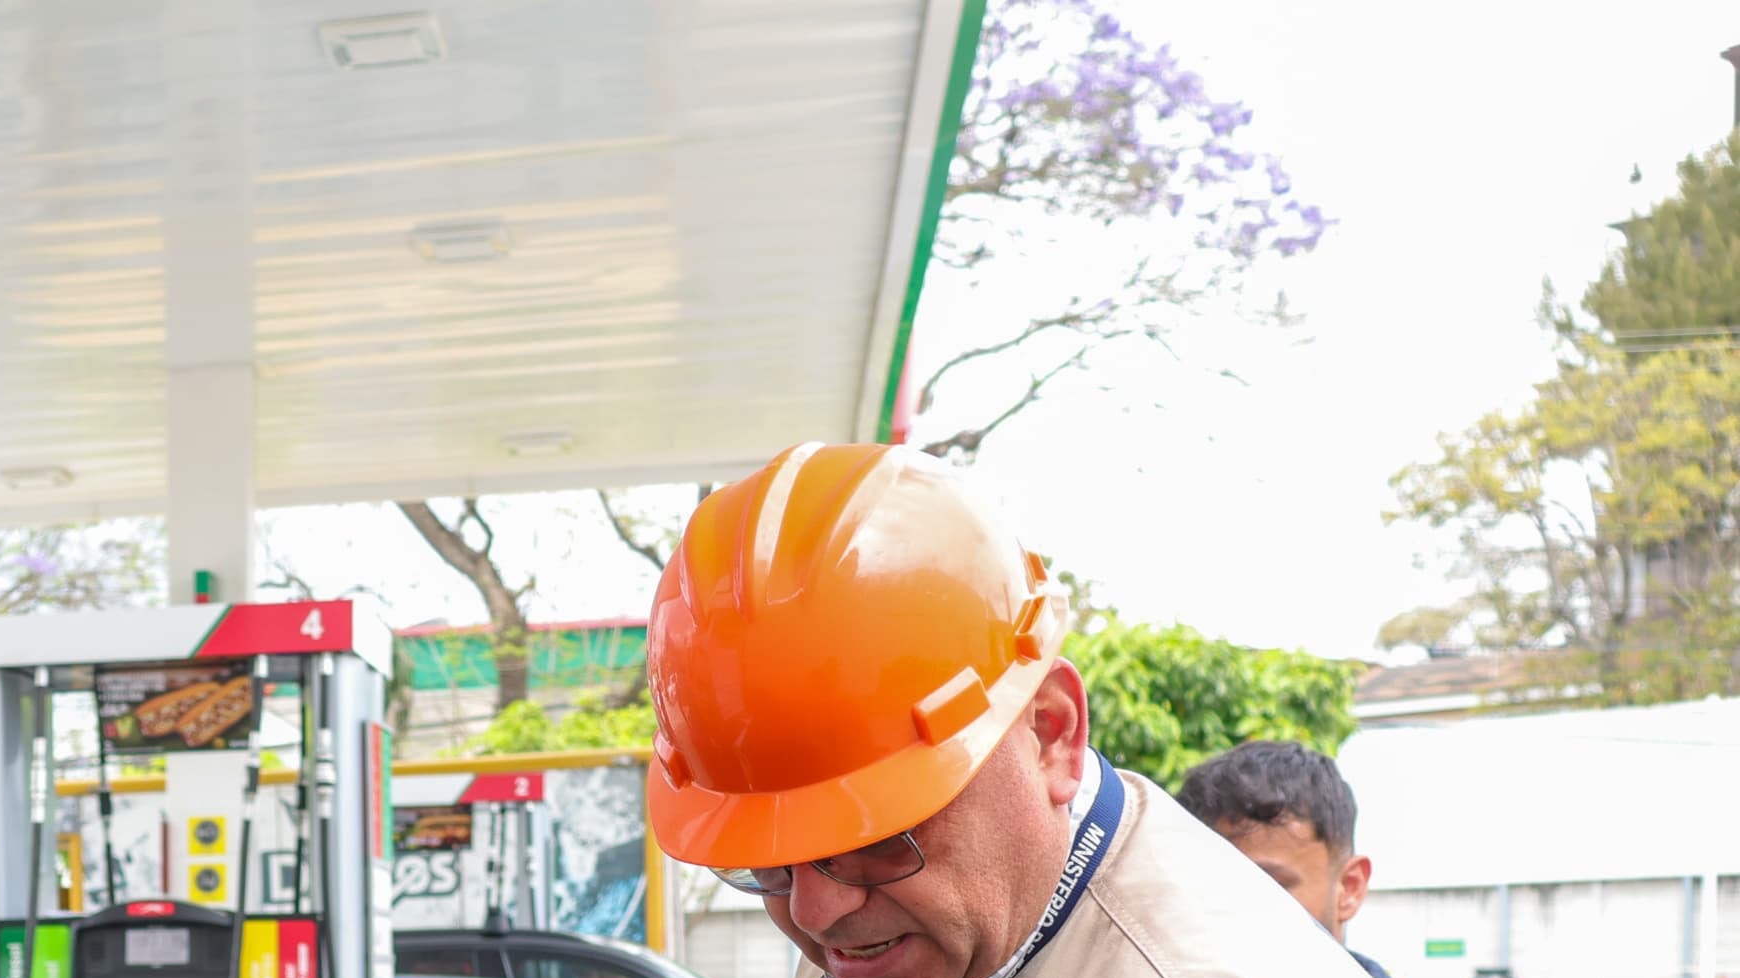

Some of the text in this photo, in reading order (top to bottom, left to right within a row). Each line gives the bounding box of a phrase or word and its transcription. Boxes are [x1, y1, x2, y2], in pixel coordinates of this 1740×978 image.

[301, 609, 324, 640] 4
[515, 777, 528, 796] 2
[1039, 822, 1106, 928] MINISTERIO
